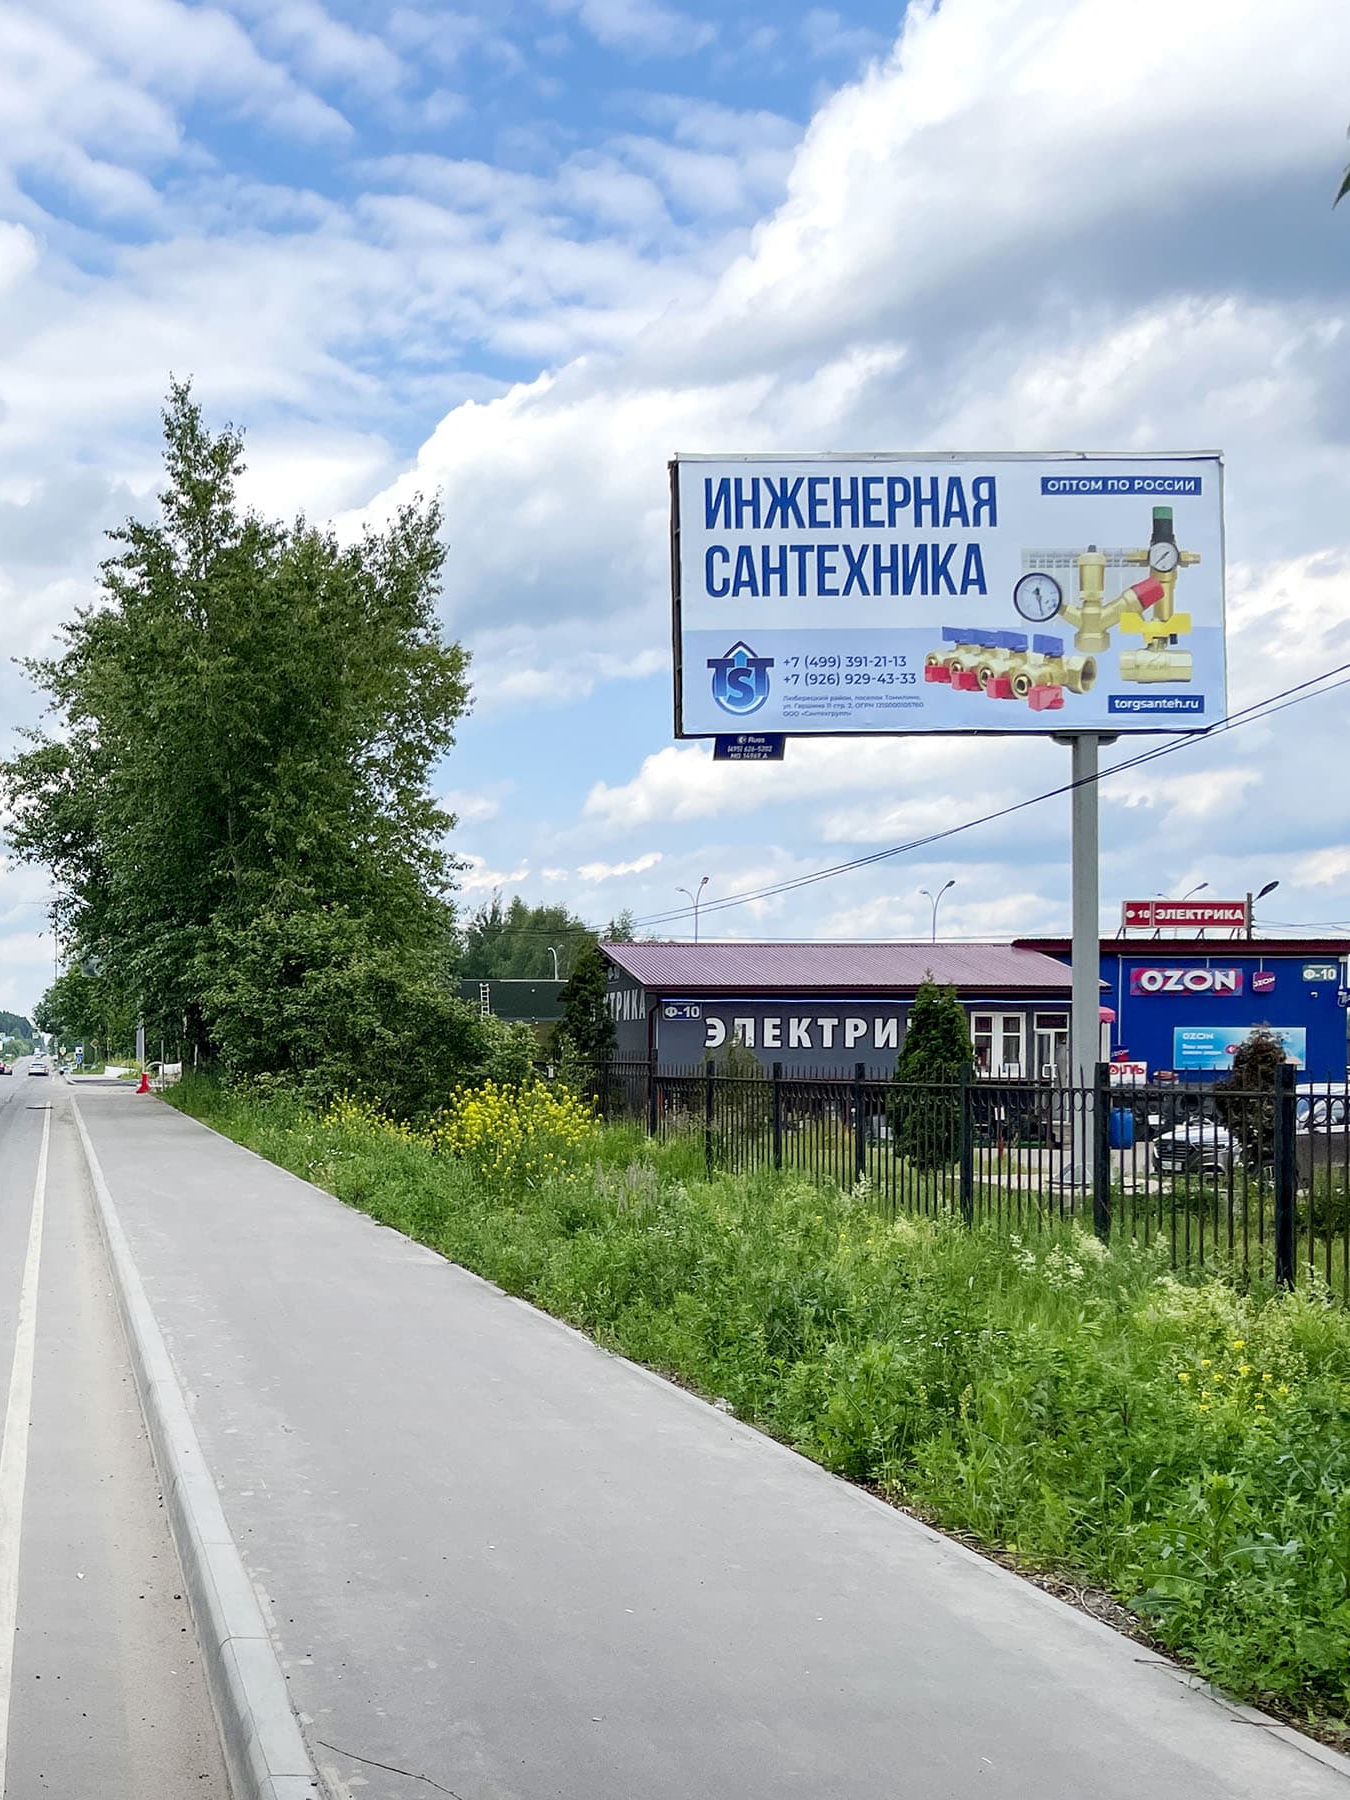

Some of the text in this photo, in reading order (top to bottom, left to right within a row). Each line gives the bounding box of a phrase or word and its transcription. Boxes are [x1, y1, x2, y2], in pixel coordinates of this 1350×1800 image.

[1047, 479, 1195, 491] ОПТОМ ПО РОССИИ
[704, 475, 998, 530] ИНЖЕНЕРНАЯ
[704, 542, 988, 598] САНТЕХНИКА
[783, 655, 907, 669] +7 (499) 391-21-13
[783, 672, 917, 686] +7 (926) 929-43-33
[1114, 698, 1199, 711] torgsanteh.ru
[1137, 909, 1151, 919] 10
[1154, 909, 1244, 920] ЭЛЕКТРИКА
[1303, 968, 1336, 980] Ф-10
[1140, 970, 1236, 992] OZON
[664, 1005, 700, 1018] Ф-10
[704, 1016, 912, 1048] ЭЛЕКТРИ
[1182, 1032, 1215, 1040] OZON
